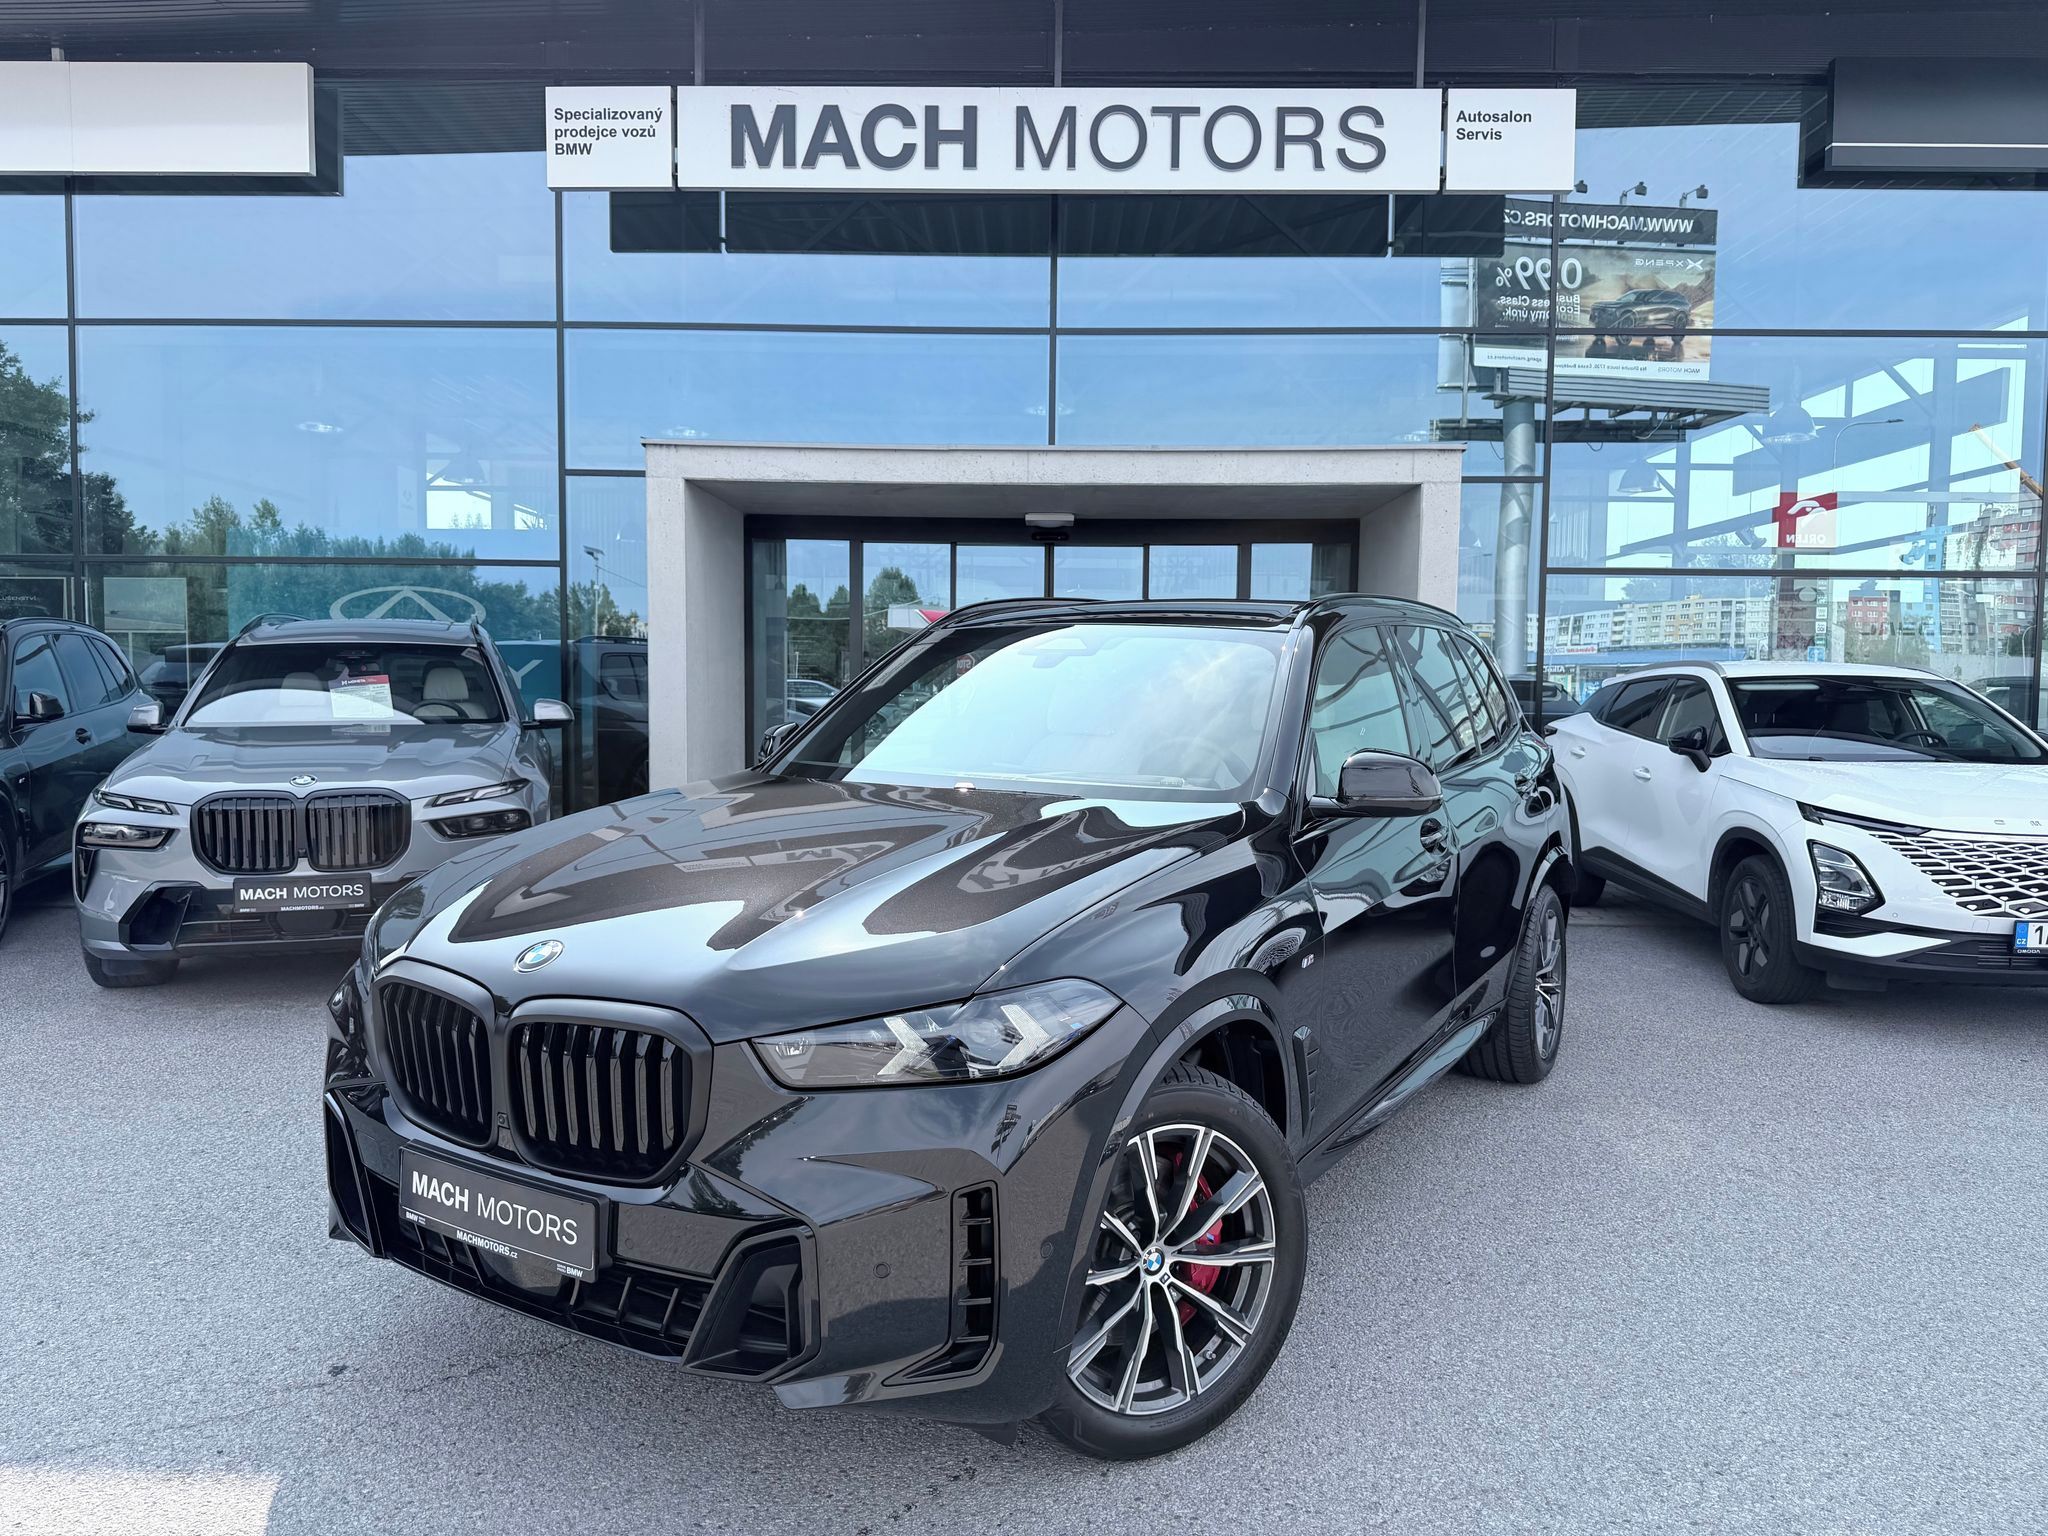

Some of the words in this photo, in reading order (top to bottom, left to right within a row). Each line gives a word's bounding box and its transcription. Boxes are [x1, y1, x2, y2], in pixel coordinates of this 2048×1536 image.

[553, 106, 663, 123] Specializovaný
[1456, 110, 1533, 123] Autosalon
[554, 124, 618, 140] prodejce
[622, 124, 656, 138] vozů
[730, 103, 979, 170] MACH
[1015, 103, 1388, 172] MOTORS
[1456, 128, 1503, 141] Servis
[554, 143, 593, 156] BMW
[239, 886, 288, 901] MACH
[293, 883, 364, 900] MOTORS
[411, 1170, 470, 1213] MACH
[477, 1192, 579, 1246] MOTORS
[456, 1229, 519, 1259] MACHMOTORS.cz
[566, 1265, 584, 1278] BMW
